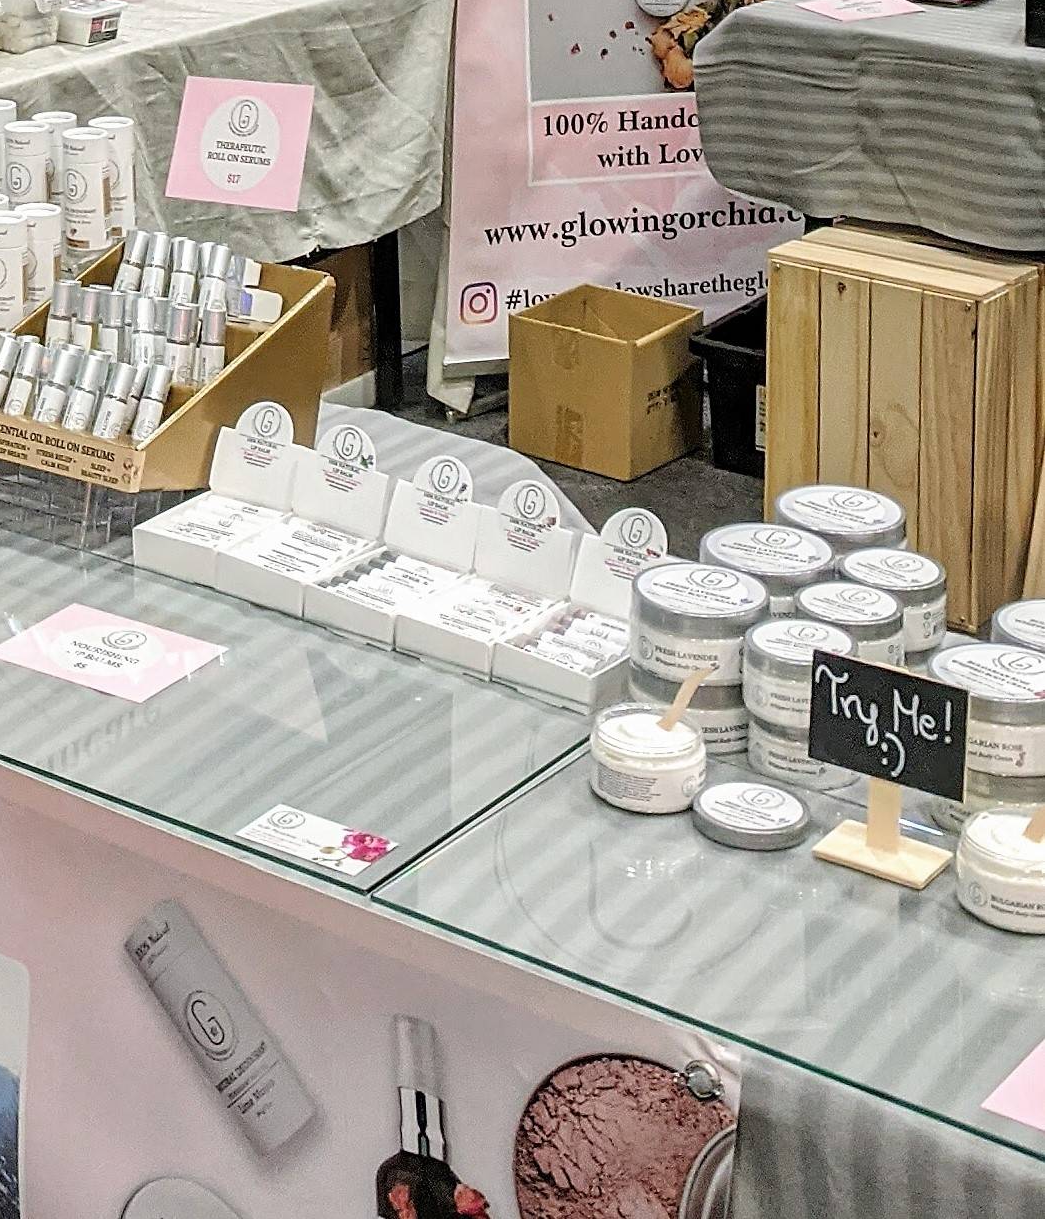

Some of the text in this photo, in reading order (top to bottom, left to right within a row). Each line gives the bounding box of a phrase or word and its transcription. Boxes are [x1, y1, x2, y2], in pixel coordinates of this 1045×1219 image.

[543, 112, 609, 137] 100%
[207, 151, 271, 166] ROLL ON SERUMS
[216, 140, 267, 154] THERAPEUTIC
[597, 145, 650, 168] with
[29, 432, 44, 443] OIL
[45, 435, 65, 449] ROLL
[66, 442, 79, 453] ON
[81, 445, 116, 462] SERUMS
[814, 665, 953, 745] Try Me!
